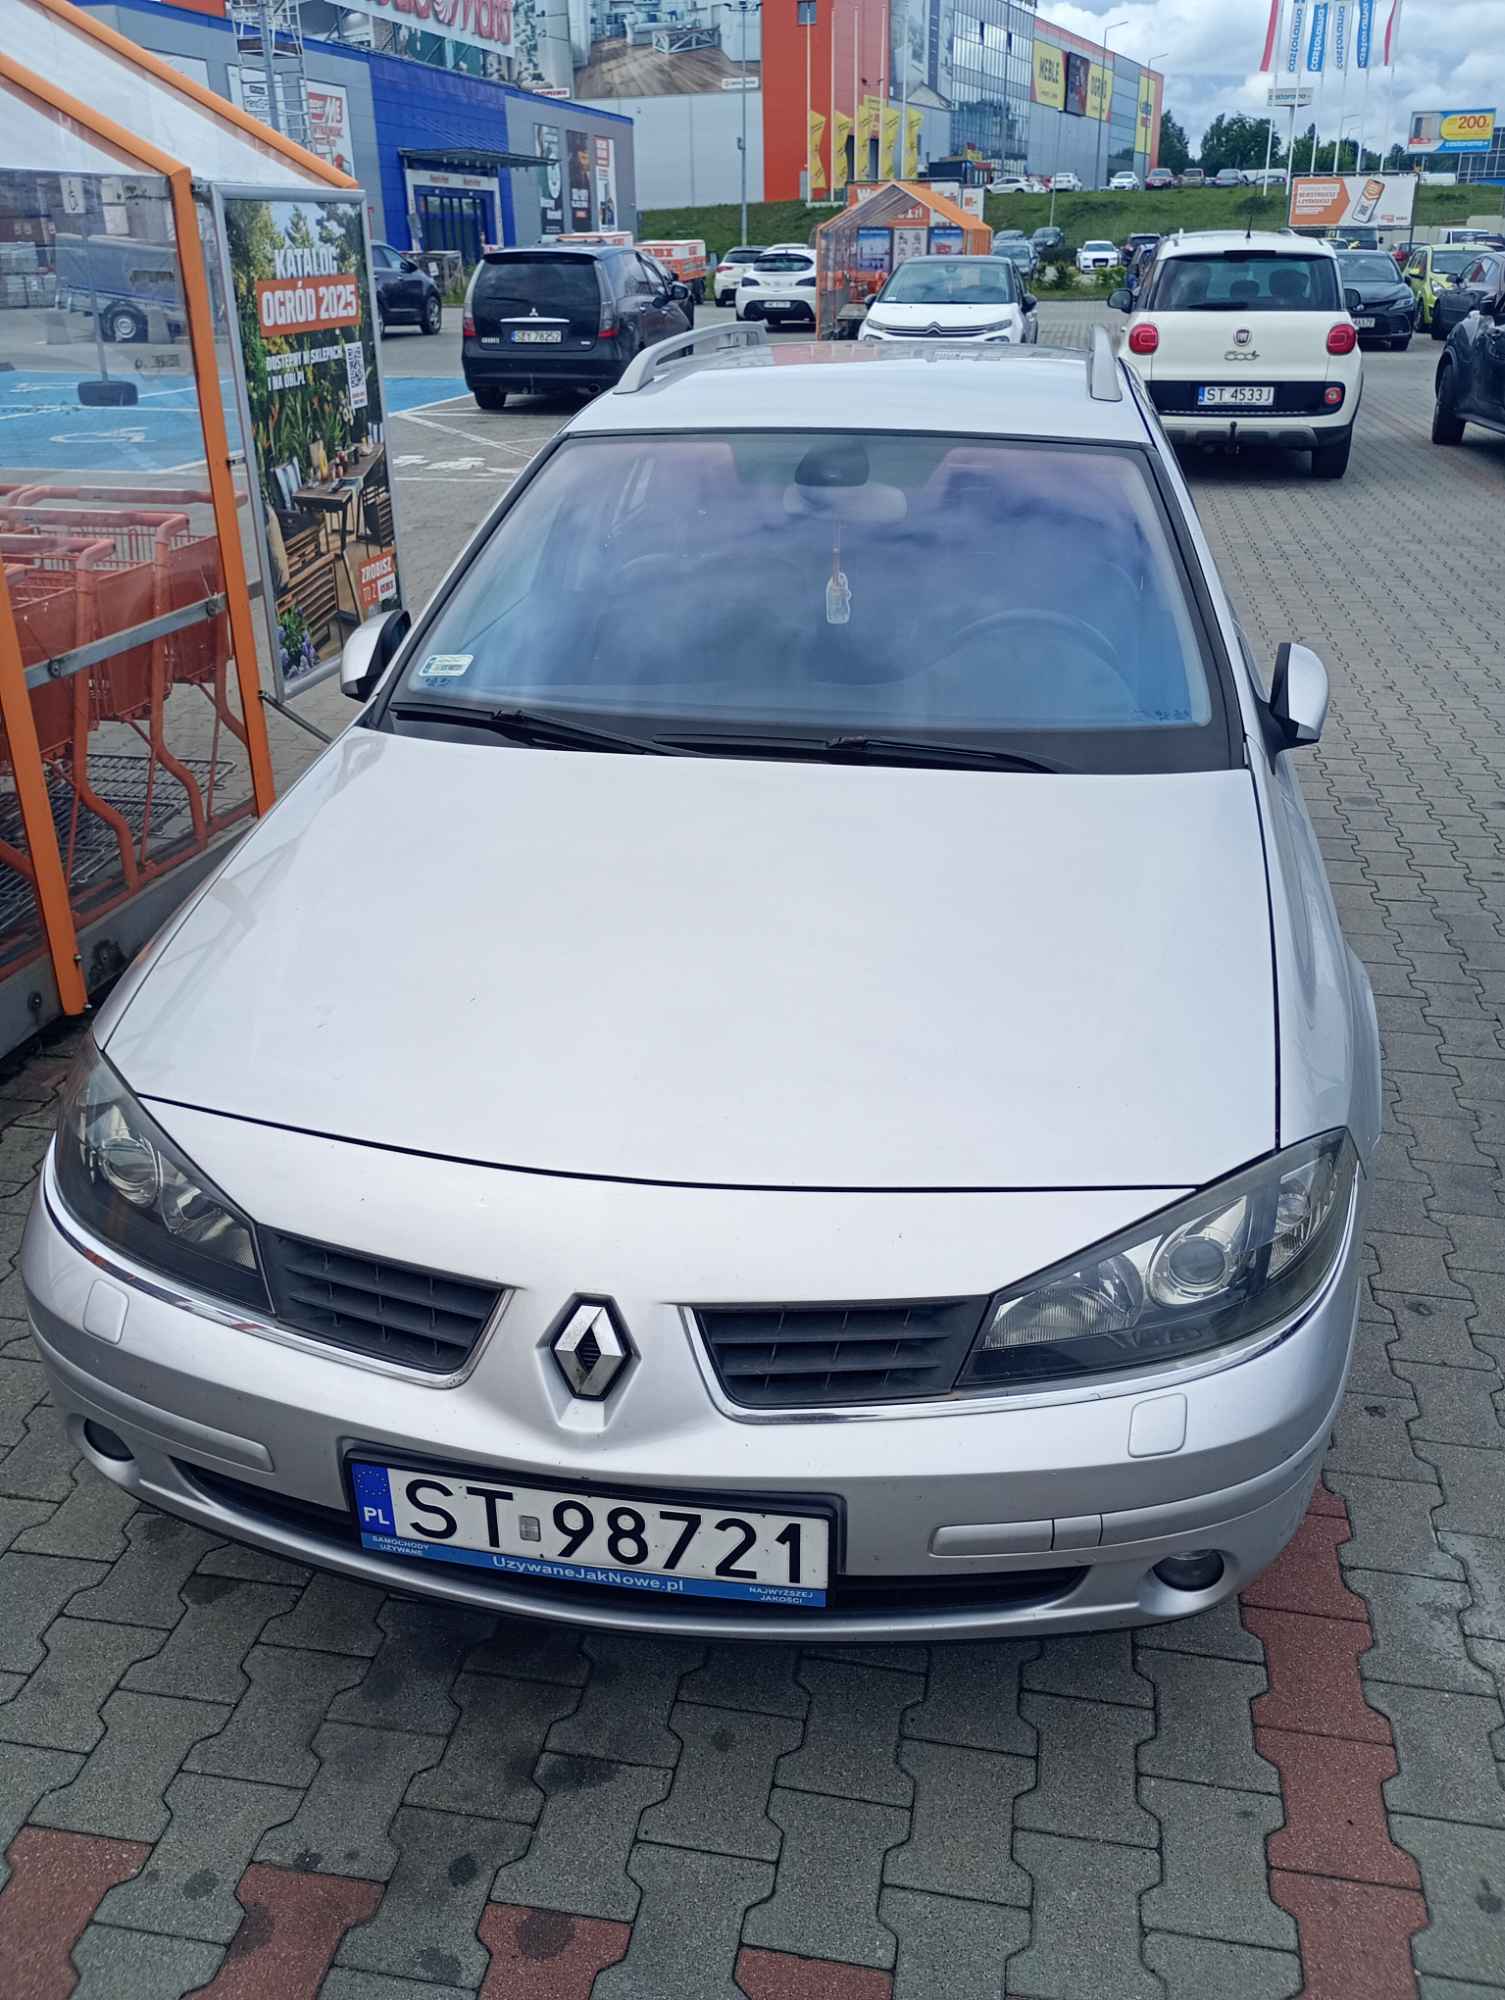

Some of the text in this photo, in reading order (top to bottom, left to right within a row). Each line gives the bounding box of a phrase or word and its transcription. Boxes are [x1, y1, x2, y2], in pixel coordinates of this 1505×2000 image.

[1458, 115, 1486, 129] 200
[274, 245, 338, 279] KATALOG
[262, 280, 357, 327] OGRÓD 2025
[272, 375, 284, 390] NA
[1206, 387, 1272, 402] ST 4533J
[363, 1506, 390, 1525] PL
[405, 1479, 802, 1584] ST 98721
[372, 1535, 430, 1550] SAMOCHODY
[492, 1556, 684, 1592] UzywaneJakNowe.pl
